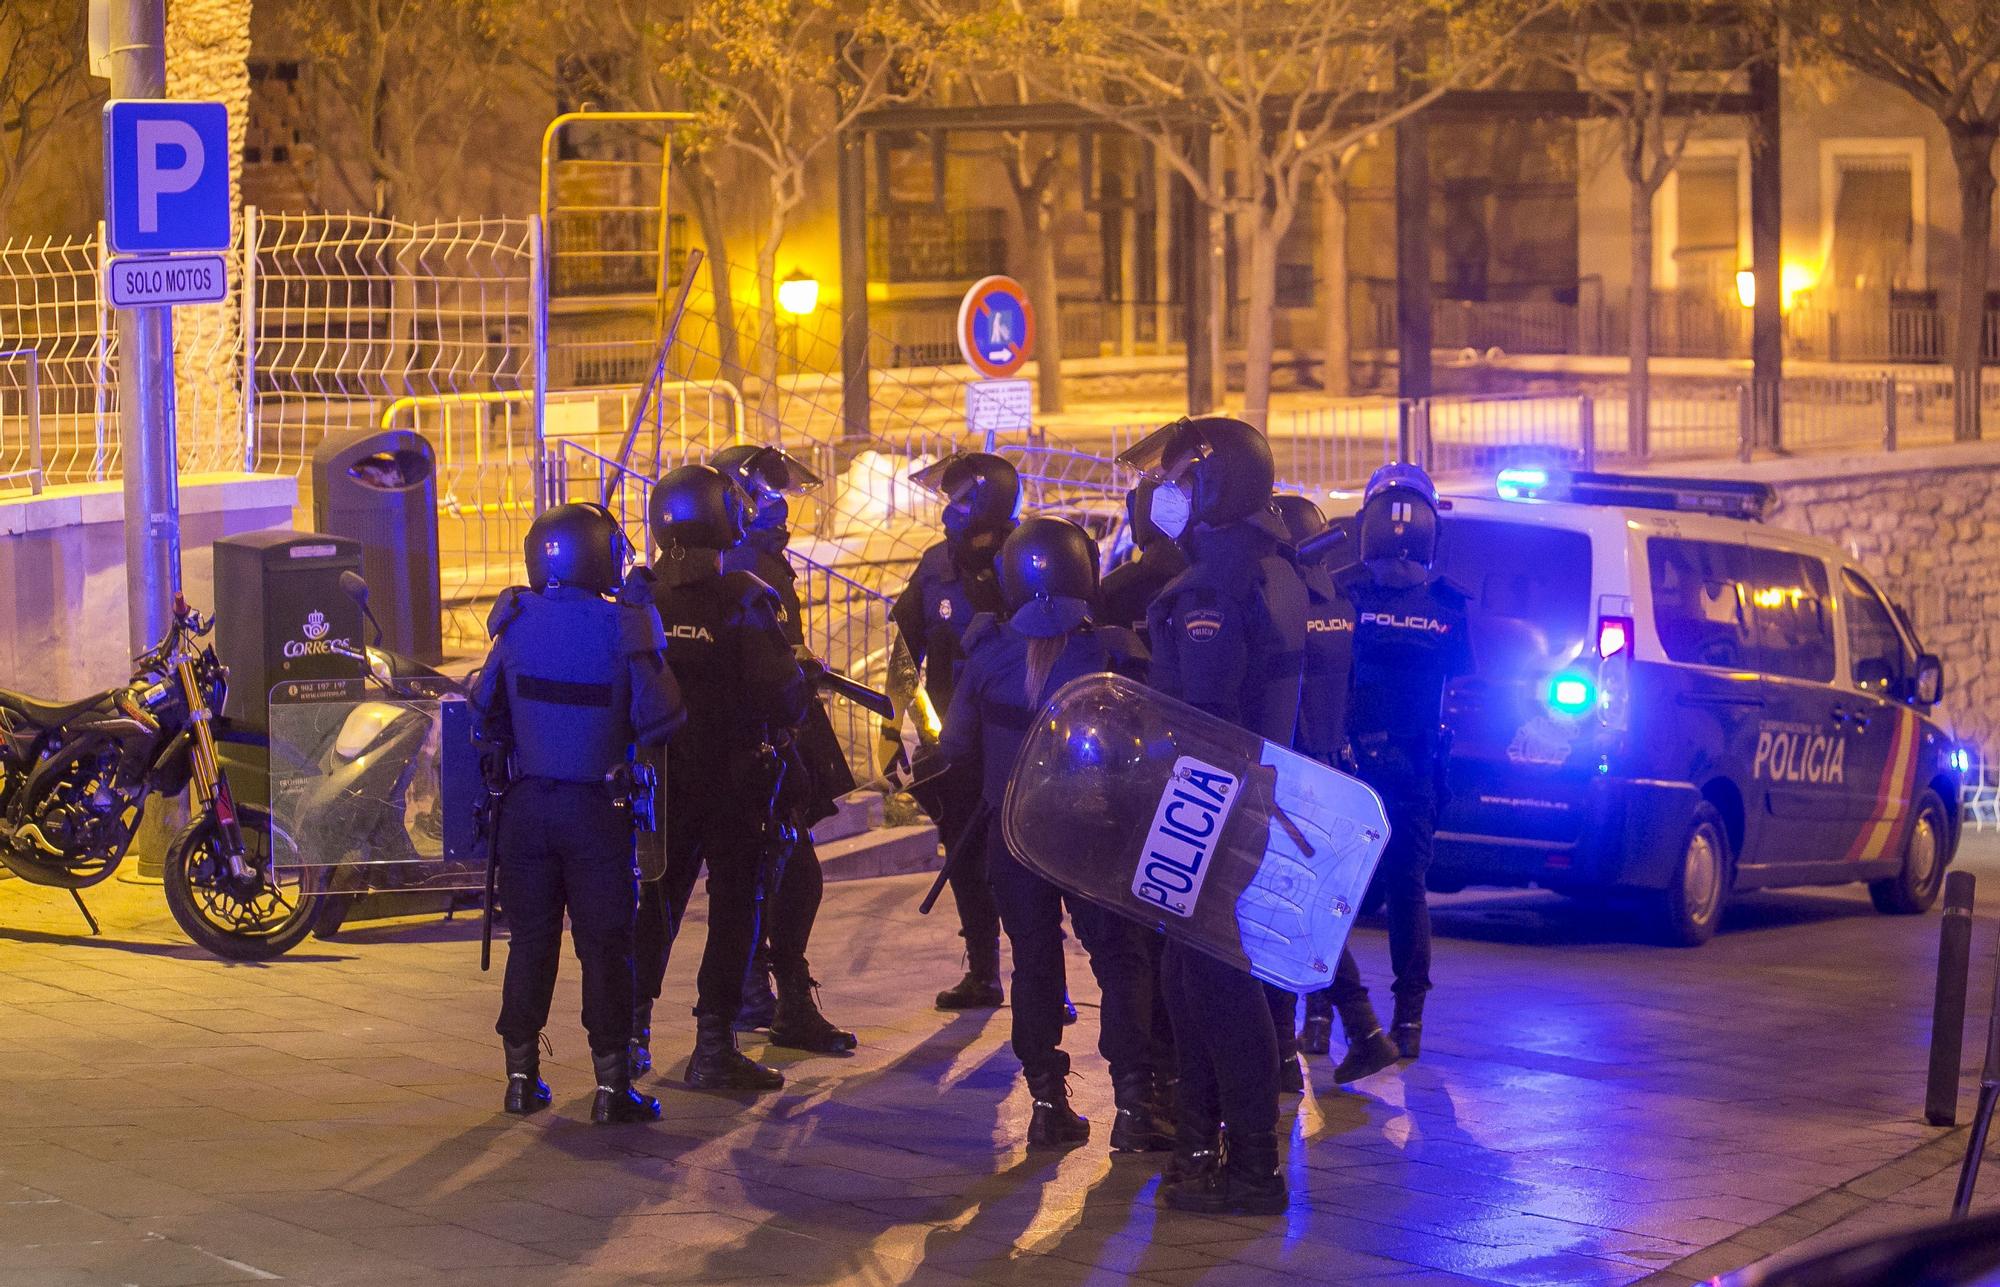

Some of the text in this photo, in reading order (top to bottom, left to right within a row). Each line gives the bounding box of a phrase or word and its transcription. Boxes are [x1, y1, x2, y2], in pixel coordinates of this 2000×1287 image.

[137, 120, 205, 233] P
[126, 268, 211, 294] SOLO MOTOS
[1307, 619, 1348, 632] POLICIA
[1361, 612, 1440, 630] POLICIA
[1753, 731, 1845, 784] POLICIA
[1138, 766, 1233, 914] POLICIA
